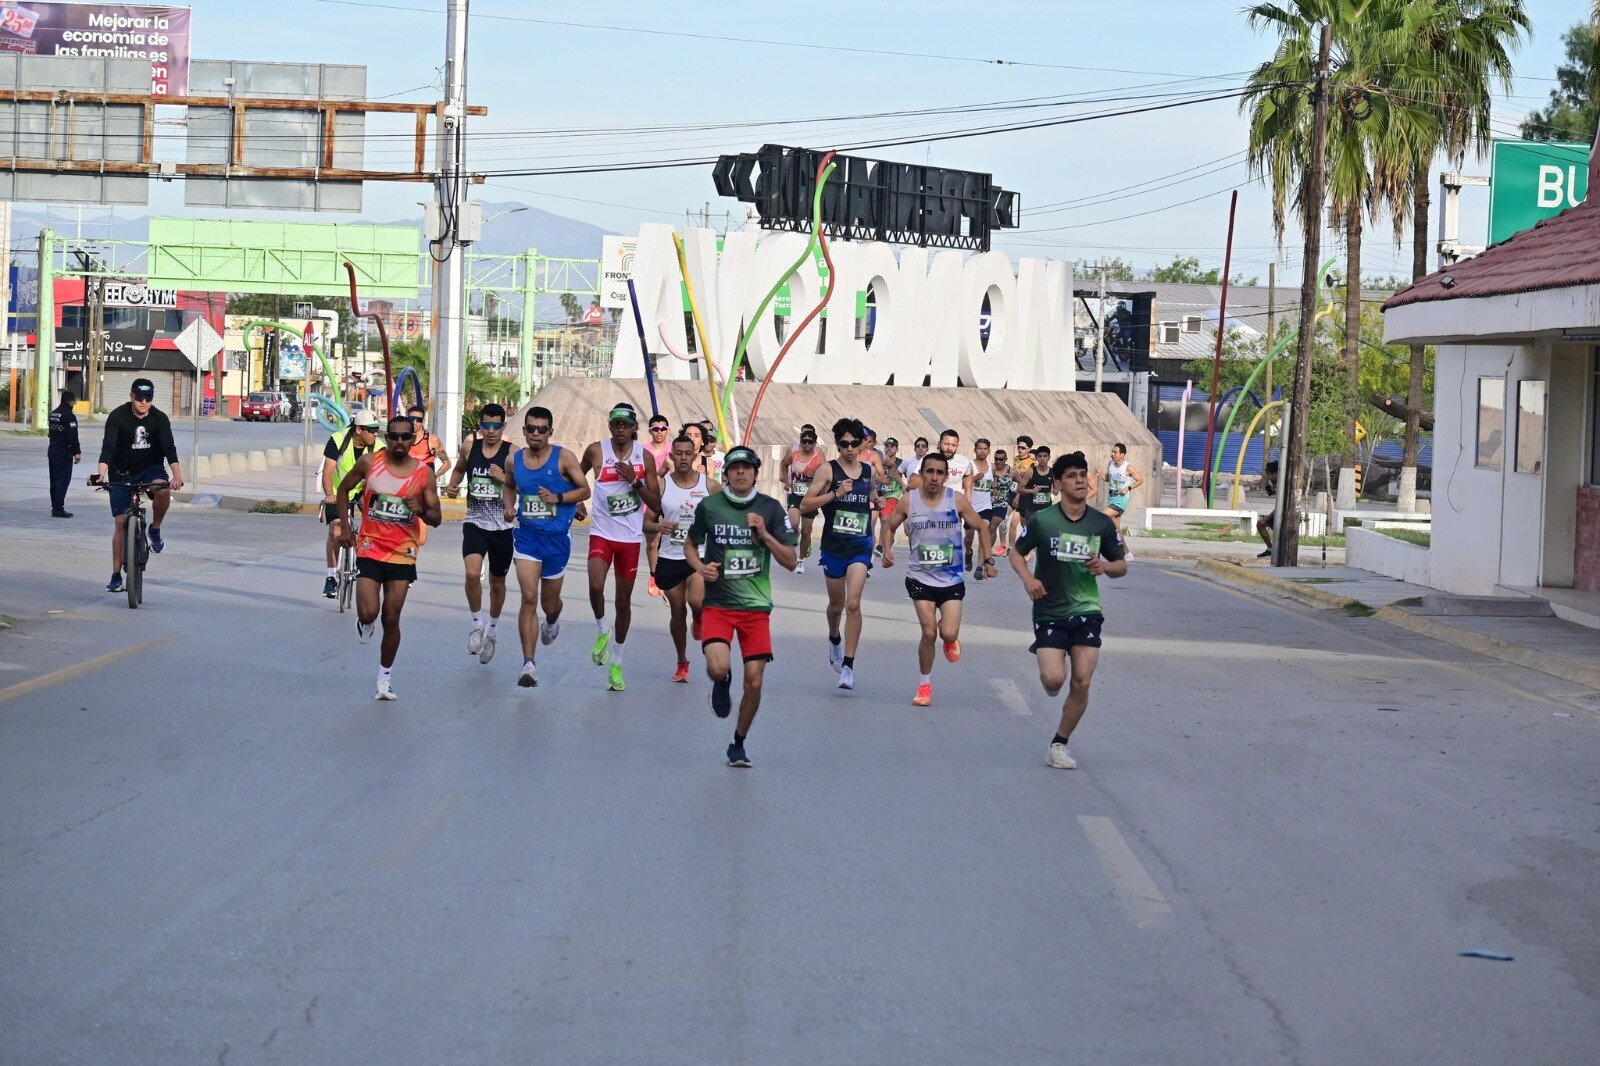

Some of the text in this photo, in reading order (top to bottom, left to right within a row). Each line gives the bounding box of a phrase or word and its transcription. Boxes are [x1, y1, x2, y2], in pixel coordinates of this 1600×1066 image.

[88, 13, 169, 32] Mejorar la
[62, 30, 168, 46] economía de
[55, 44, 168, 63] las familias es
[473, 483, 495, 494] 238
[382, 501, 405, 514] 146
[525, 501, 547, 513] 185
[612, 498, 635, 511] 225
[840, 516, 860, 528] 199
[714, 524, 726, 536] El
[715, 537, 728, 545] de
[1065, 541, 1090, 556] 150
[922, 550, 945, 561] 198
[730, 557, 758, 570] 314
